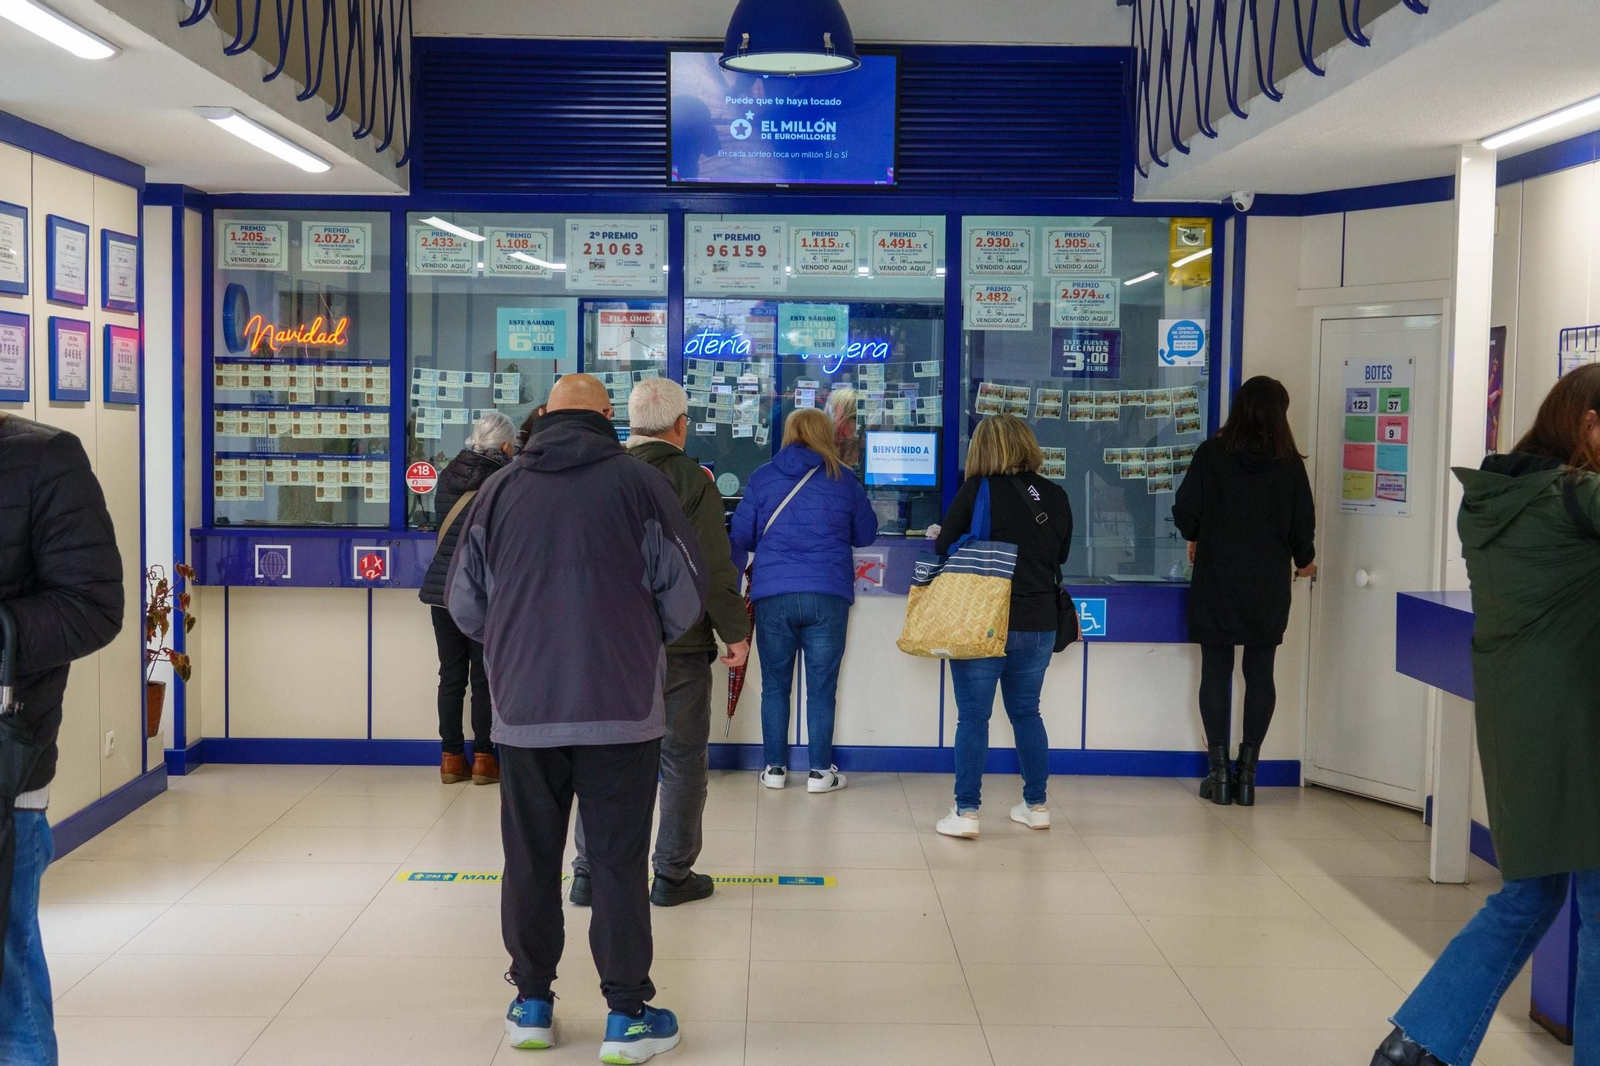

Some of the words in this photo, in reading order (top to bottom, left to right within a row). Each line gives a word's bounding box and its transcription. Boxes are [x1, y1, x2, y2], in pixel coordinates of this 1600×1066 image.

[726, 96, 753, 104] Puede
[756, 98, 772, 106] que
[787, 97, 808, 107] haya
[762, 120, 778, 132] EL
[781, 118, 836, 133] MILLÓN
[583, 243, 644, 256] 21063
[706, 244, 766, 257] 96159
[244, 315, 350, 353] Navidad
[684, 328, 751, 354] otería
[1365, 365, 1392, 380] BOTES
[1353, 400, 1368, 409] 123
[1389, 402, 1399, 410] 37
[1389, 430, 1394, 438] 9
[872, 445, 921, 454] BIENVENIDO
[412, 465, 430, 475] +18
